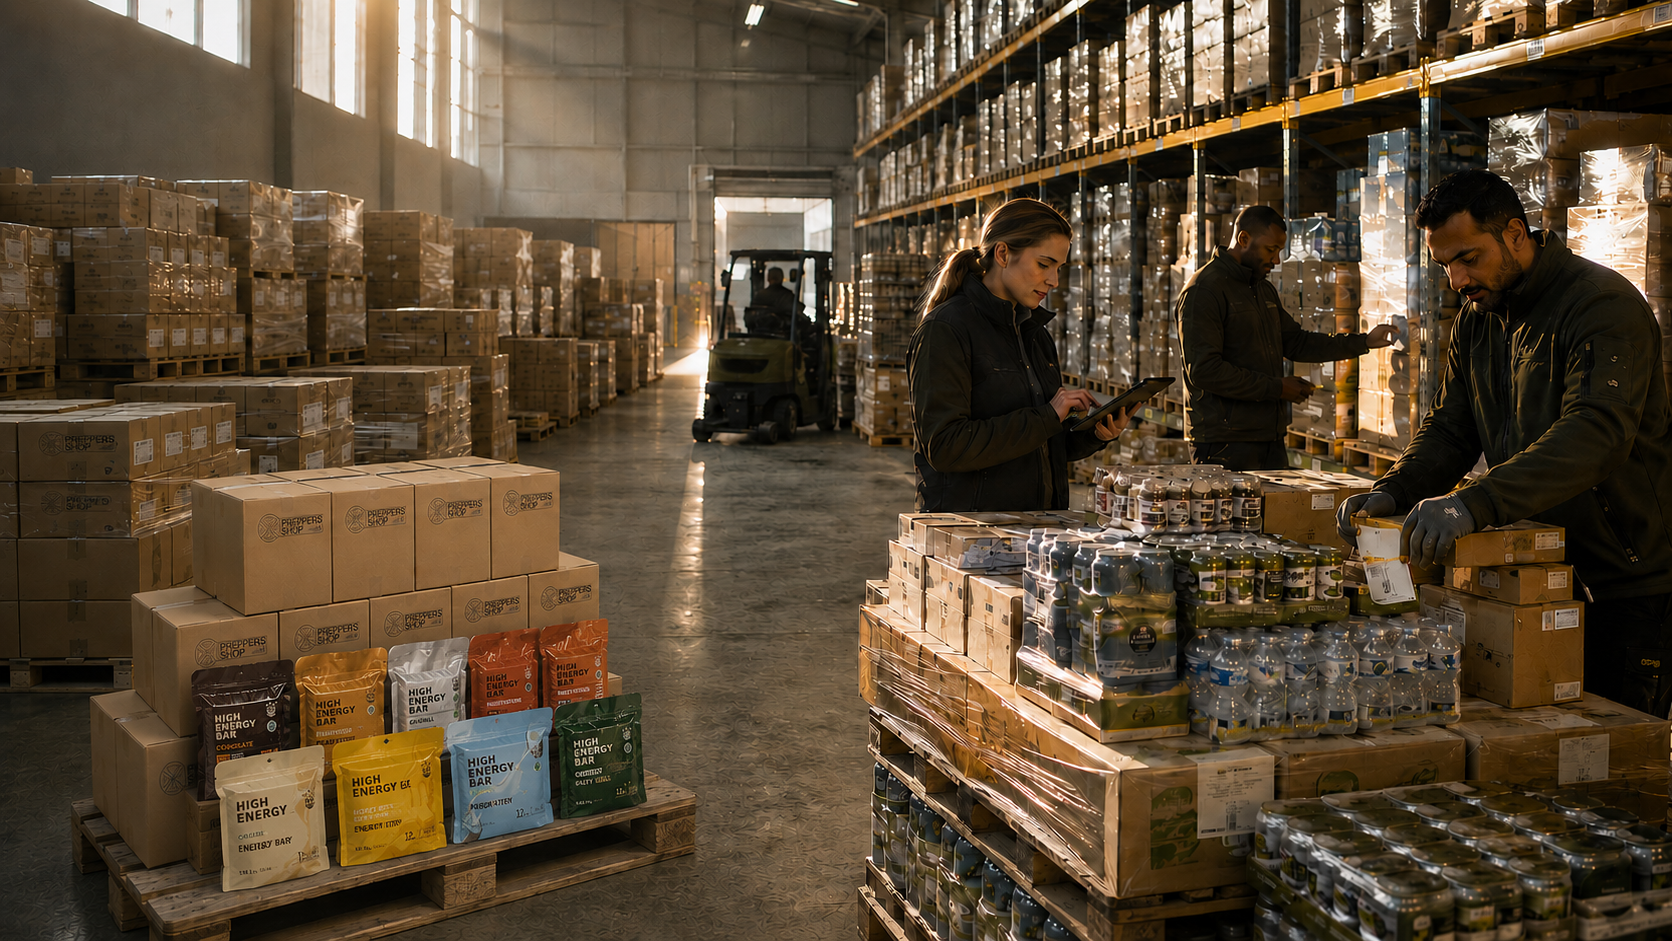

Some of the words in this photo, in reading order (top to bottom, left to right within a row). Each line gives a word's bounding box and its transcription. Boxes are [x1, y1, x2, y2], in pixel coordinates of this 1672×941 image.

[64, 435, 115, 444] PREPPERS
[65, 443, 92, 451] SHOP
[447, 499, 483, 510] PREPPERS
[367, 507, 406, 518] PREPPERS
[447, 507, 466, 517] SHOP
[281, 514, 323, 526] PREPPERS
[367, 516, 388, 527] SHOP
[281, 526, 303, 536] SHOP
[558, 585, 592, 598] PREPPERS
[484, 597, 520, 610] PREPPERS
[558, 594, 577, 604] SHOP
[404, 609, 443, 623] PREPPERS
[484, 606, 503, 616] SHOP
[317, 622, 359, 636] PREPPERS
[405, 619, 426, 631] SHOP
[220, 636, 266, 651] PREPPERS
[317, 633, 340, 645] SHOP
[220, 648, 245, 659] SHOP
[486, 673, 507, 682] HIGH
[409, 686, 432, 697] HIGH
[316, 699, 341, 709] HIGH
[409, 693, 446, 706] ENERGY
[316, 706, 355, 718] ENERGY
[409, 705, 428, 715] BAR
[214, 712, 240, 723] HIGH
[316, 717, 337, 726] BAR
[215, 719, 256, 732] ENERGY
[216, 730, 237, 740] BAR
[573, 737, 599, 748] HIGH
[574, 743, 613, 757] ENERGY
[468, 755, 495, 768] HIGH
[574, 756, 595, 767] BAR
[468, 762, 514, 778] ENERGY
[352, 774, 381, 787] HIGH
[469, 776, 492, 788] BAR
[352, 782, 397, 798] ENERGY
[236, 797, 268, 812] HIGH
[237, 805, 287, 823] ENERGY
